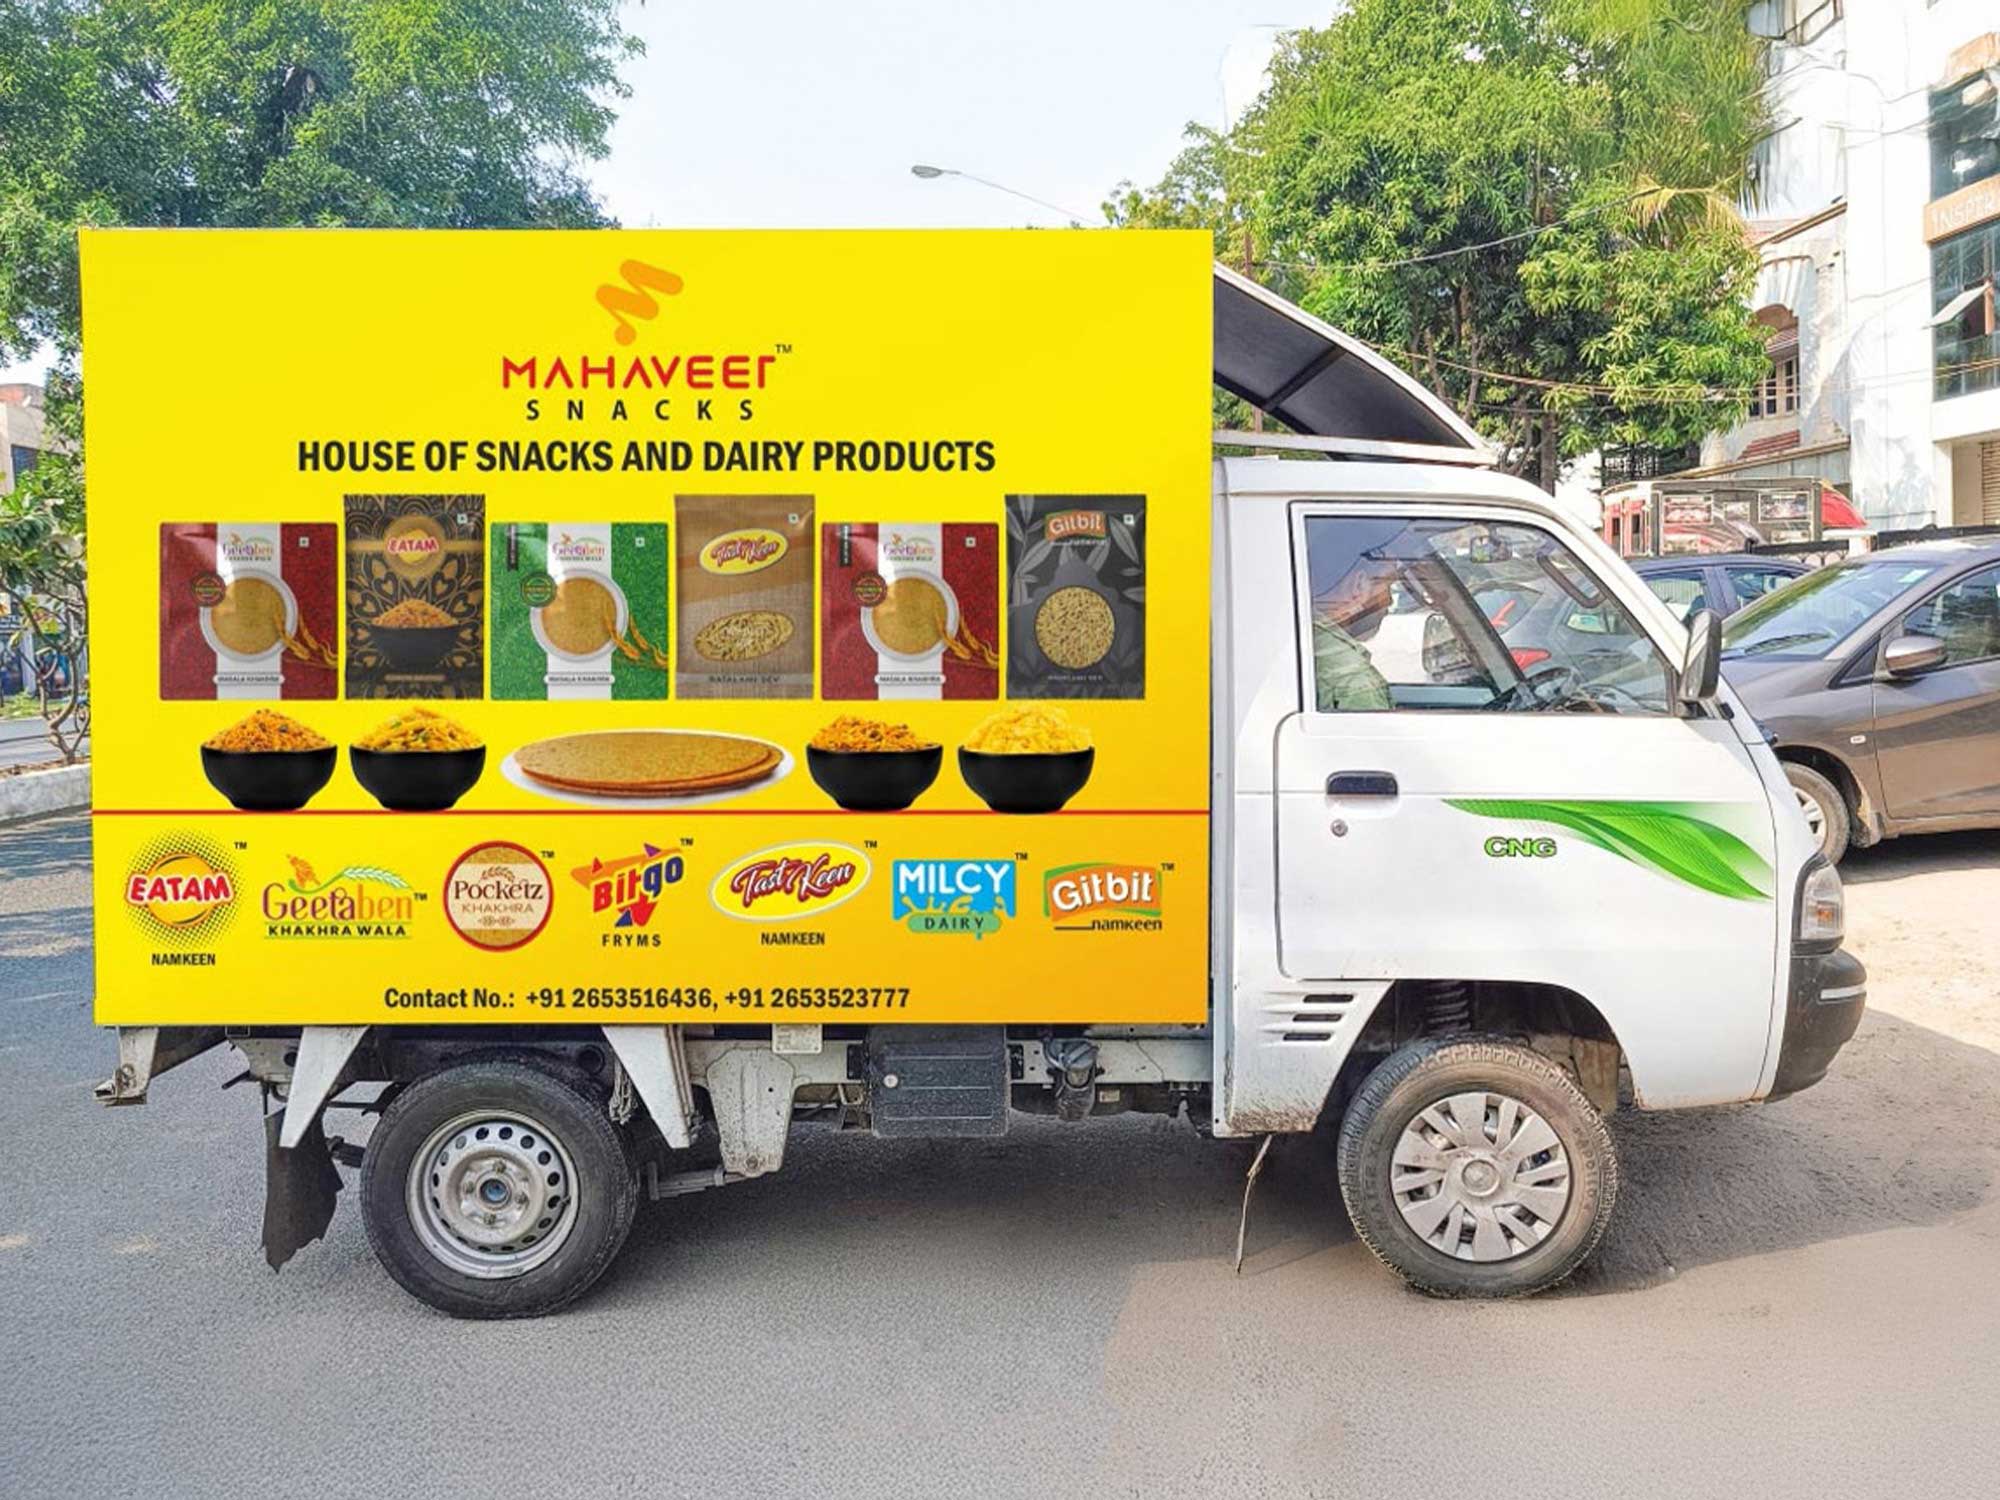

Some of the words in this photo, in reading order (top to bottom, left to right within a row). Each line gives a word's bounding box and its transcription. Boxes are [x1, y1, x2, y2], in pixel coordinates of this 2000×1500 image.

[526, 399, 754, 421] SNACKS
[298, 440, 416, 472] HOUSE
[423, 440, 469, 472] OF
[475, 440, 614, 472] SNACKS
[621, 440, 693, 472] AND
[703, 440, 805, 472] DAIRY
[812, 440, 997, 472] PRODUCTS
[234, 842, 247, 850] TM
[1484, 836, 1557, 857] CNG
[129, 873, 232, 903] EATAM
[454, 879, 543, 900] Pocketz
[592, 855, 684, 913] Bitgo
[898, 863, 1010, 895] MILCY
[262, 883, 413, 921] Geetaben
[1051, 871, 1154, 912] Gitbit
[462, 903, 534, 913] KHAKHRA
[268, 925, 352, 937] KHAKHRA
[356, 925, 406, 937] WALA
[924, 917, 984, 930] DAIRY
[1091, 919, 1162, 931] namkeen
[602, 934, 662, 947] FRYMS
[761, 932, 825, 945] NAMKEEN
[151, 953, 216, 966] NAMKEEN
[384, 988, 468, 1009] Contact
[526, 988, 566, 1009] +91
[572, 988, 718, 1012] 2653516436,
[725, 988, 765, 1009] +91
[771, 988, 910, 1009] 2653523777
